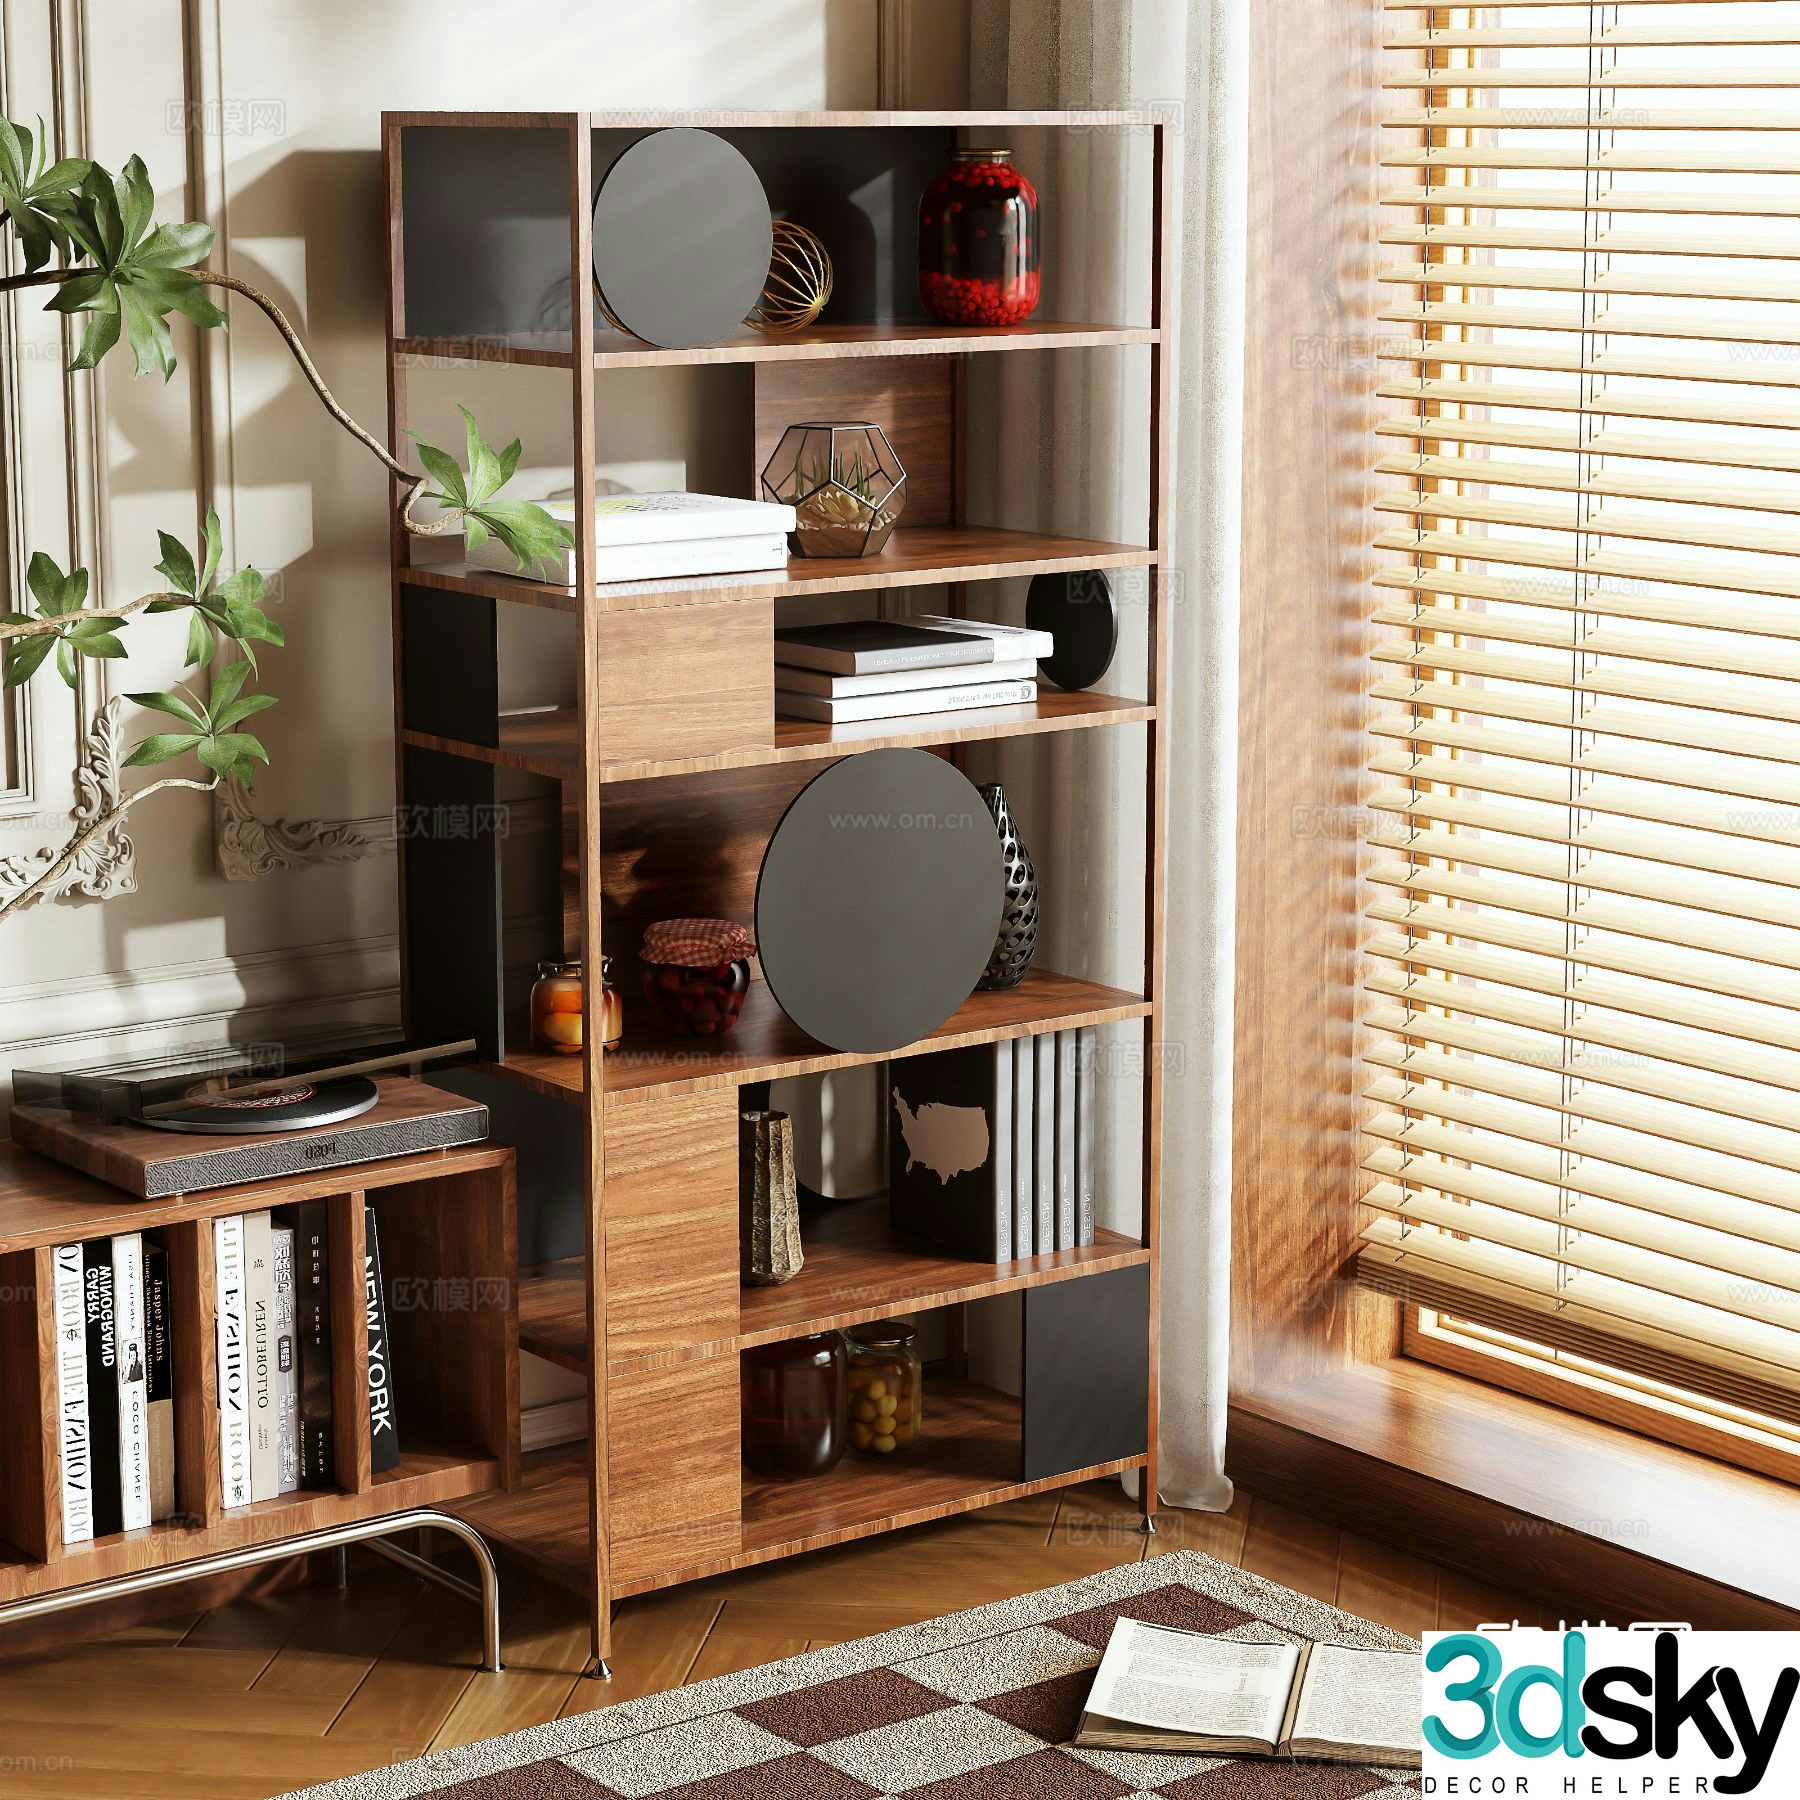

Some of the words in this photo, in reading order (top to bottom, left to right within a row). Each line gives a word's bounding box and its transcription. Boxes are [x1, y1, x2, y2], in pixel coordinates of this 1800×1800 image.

[153, 1279, 163, 1321] Jasper
[155, 1325, 165, 1362] Johns
[368, 1338, 392, 1436] YORK
